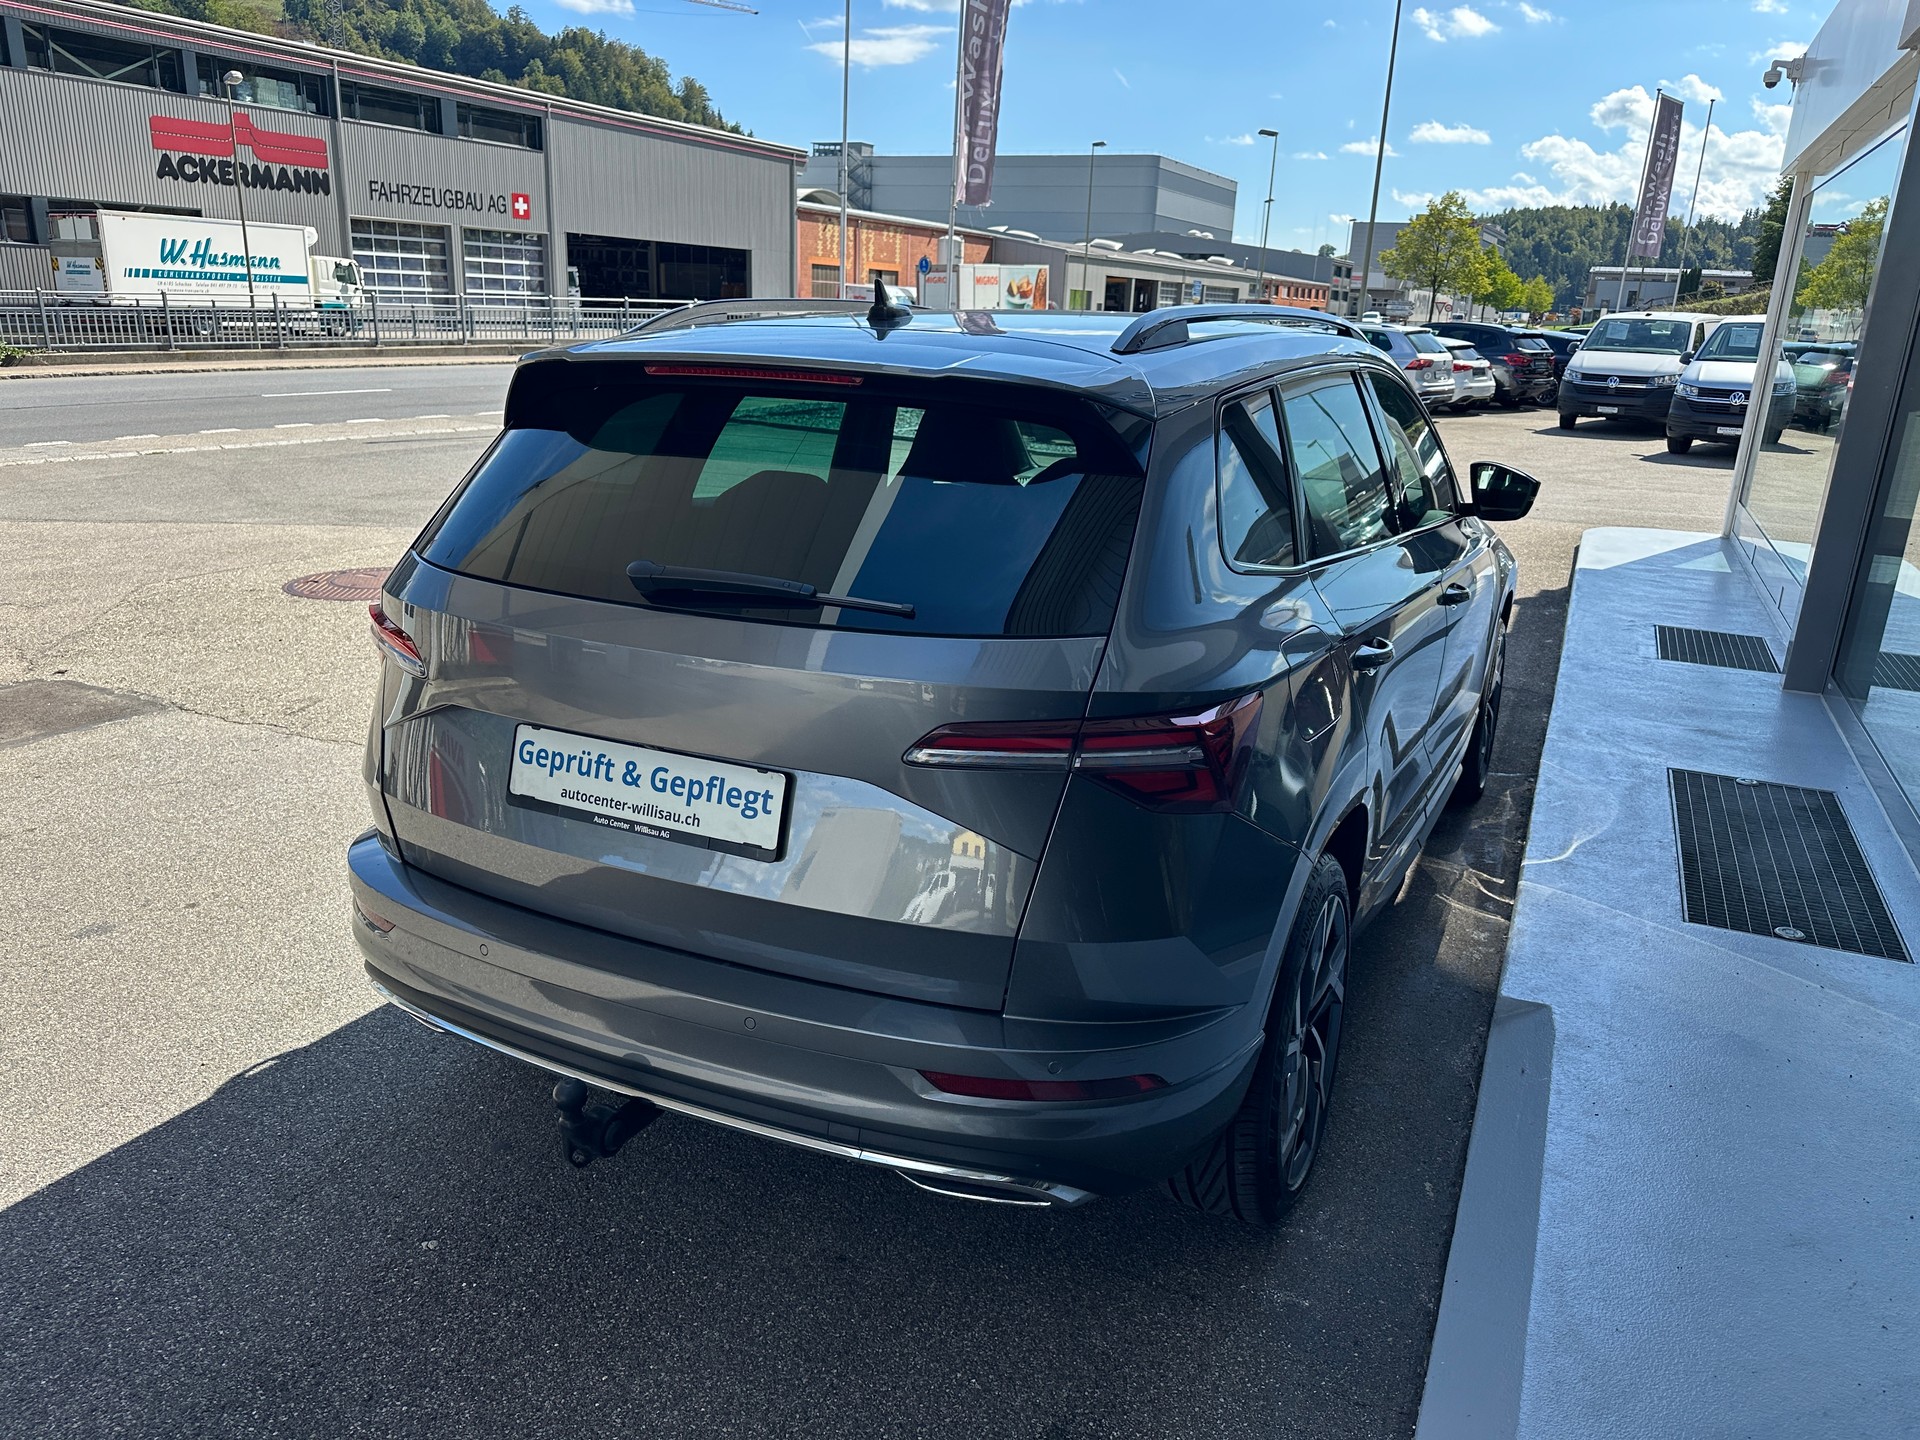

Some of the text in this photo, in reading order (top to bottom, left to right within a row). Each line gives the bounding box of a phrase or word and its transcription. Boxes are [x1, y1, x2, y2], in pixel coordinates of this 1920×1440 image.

[968, 72, 993, 185] DeLux
[157, 153, 330, 196] ACKERMANN
[369, 180, 507, 214] FAHRZEUGBAU AG
[1646, 176, 1670, 244] DeLux
[158, 269, 230, 280] KÜHLTRANSPORTE
[418, 276, 425, 287] 1
[518, 280, 524, 291] 2
[976, 276, 998, 285] MIGROS
[518, 739, 774, 819] Geprüft & Gepflegt
[560, 786, 701, 828] autocenter-willisau.ch
[593, 815, 671, 839] Auto Center Willisau AG
